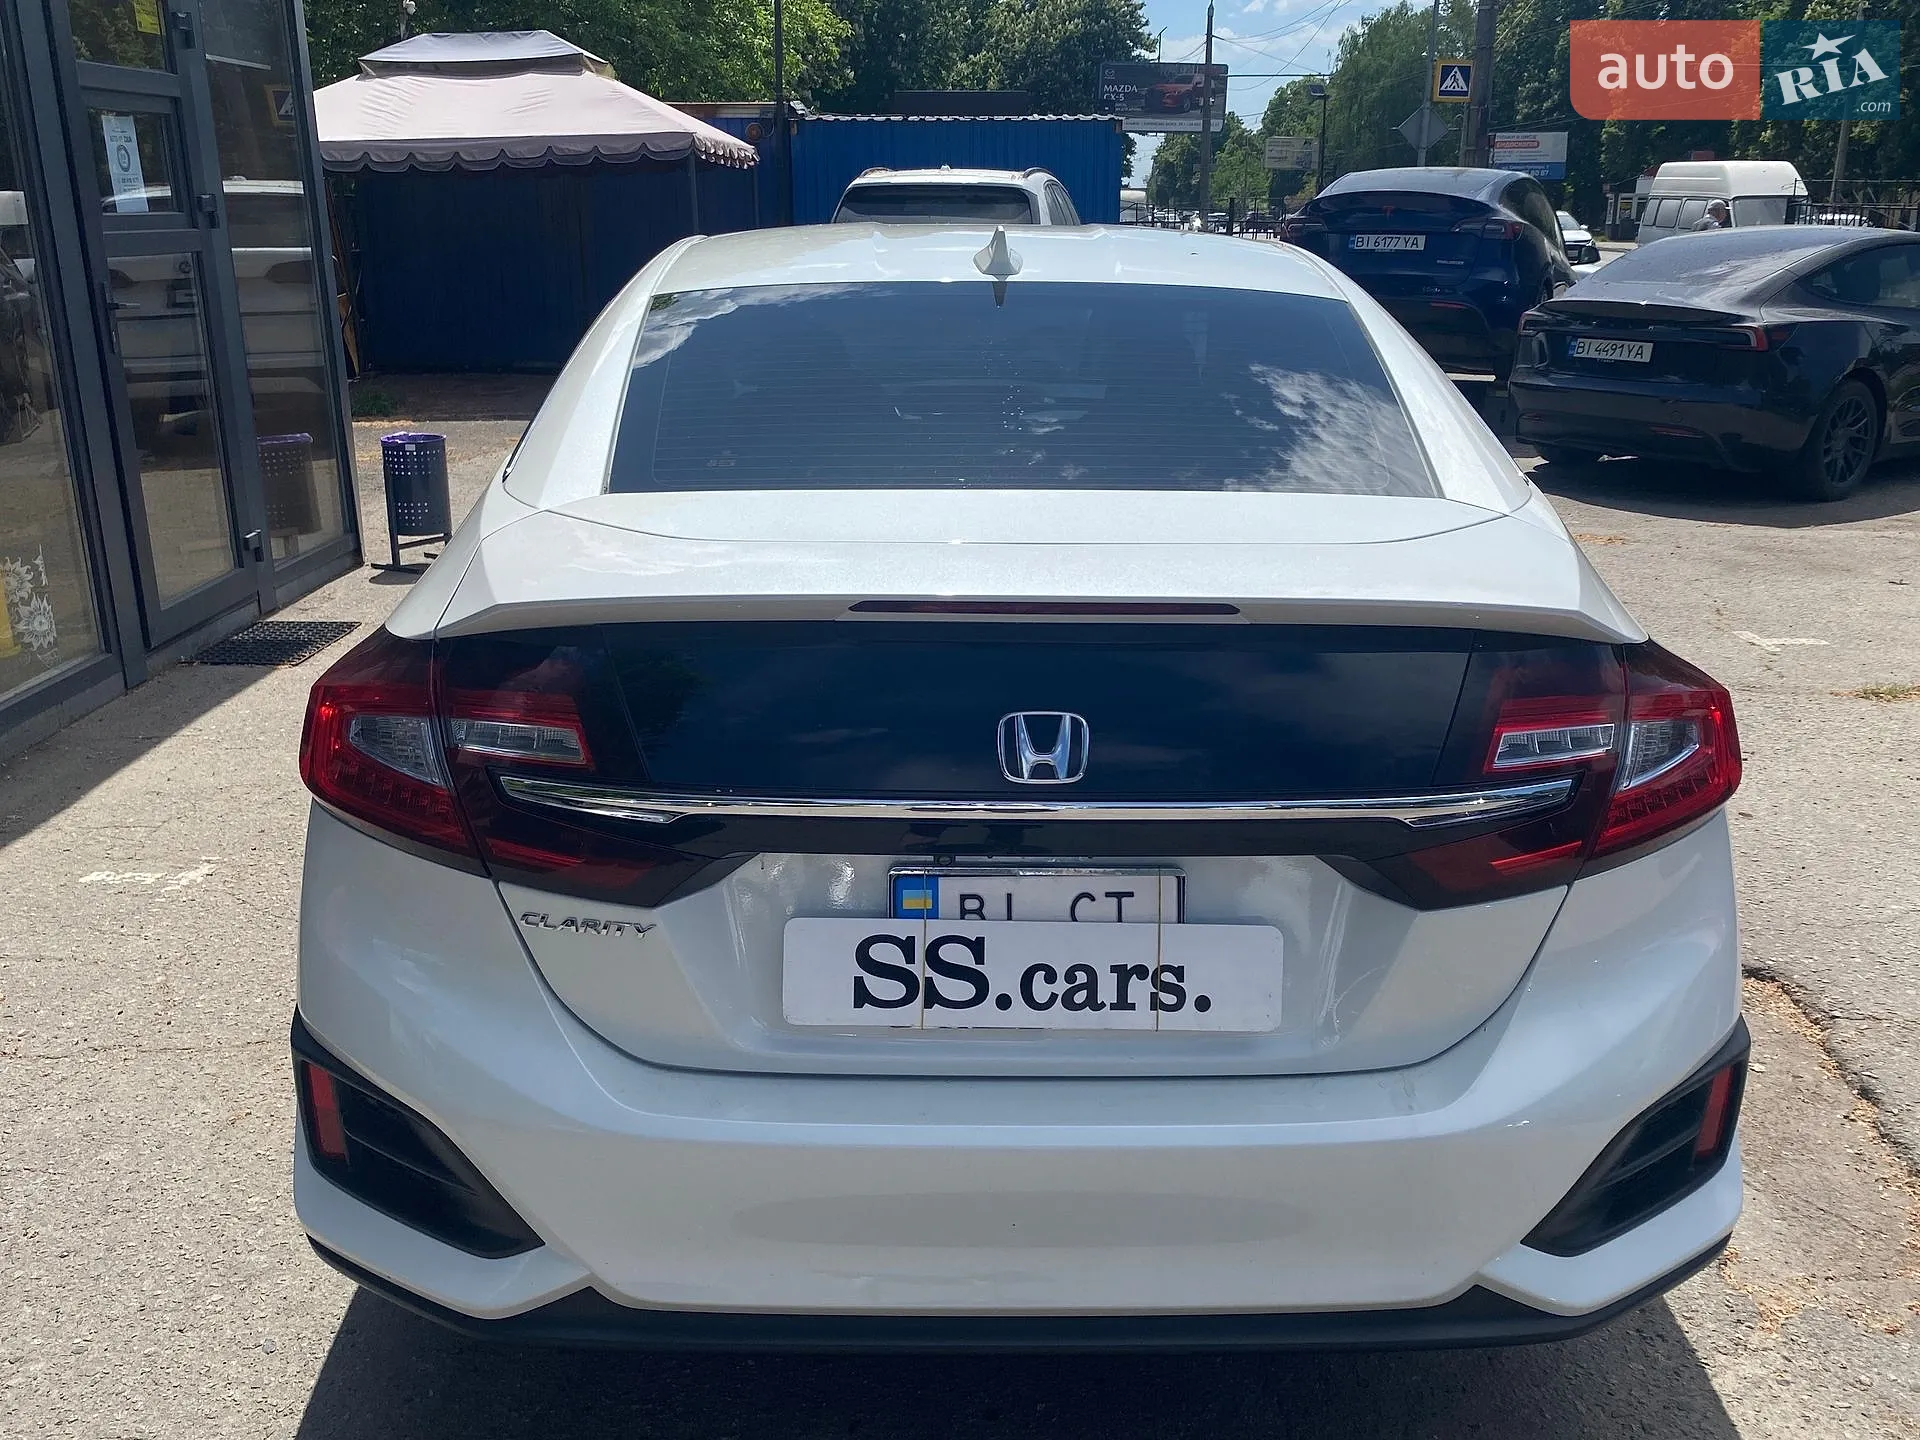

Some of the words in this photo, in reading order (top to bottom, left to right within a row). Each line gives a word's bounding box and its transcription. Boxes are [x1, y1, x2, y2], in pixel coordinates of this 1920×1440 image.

[1103, 84, 1138, 93] MAZDA
[1103, 93, 1125, 102] CX-5
[520, 911, 657, 939] CLARITY
